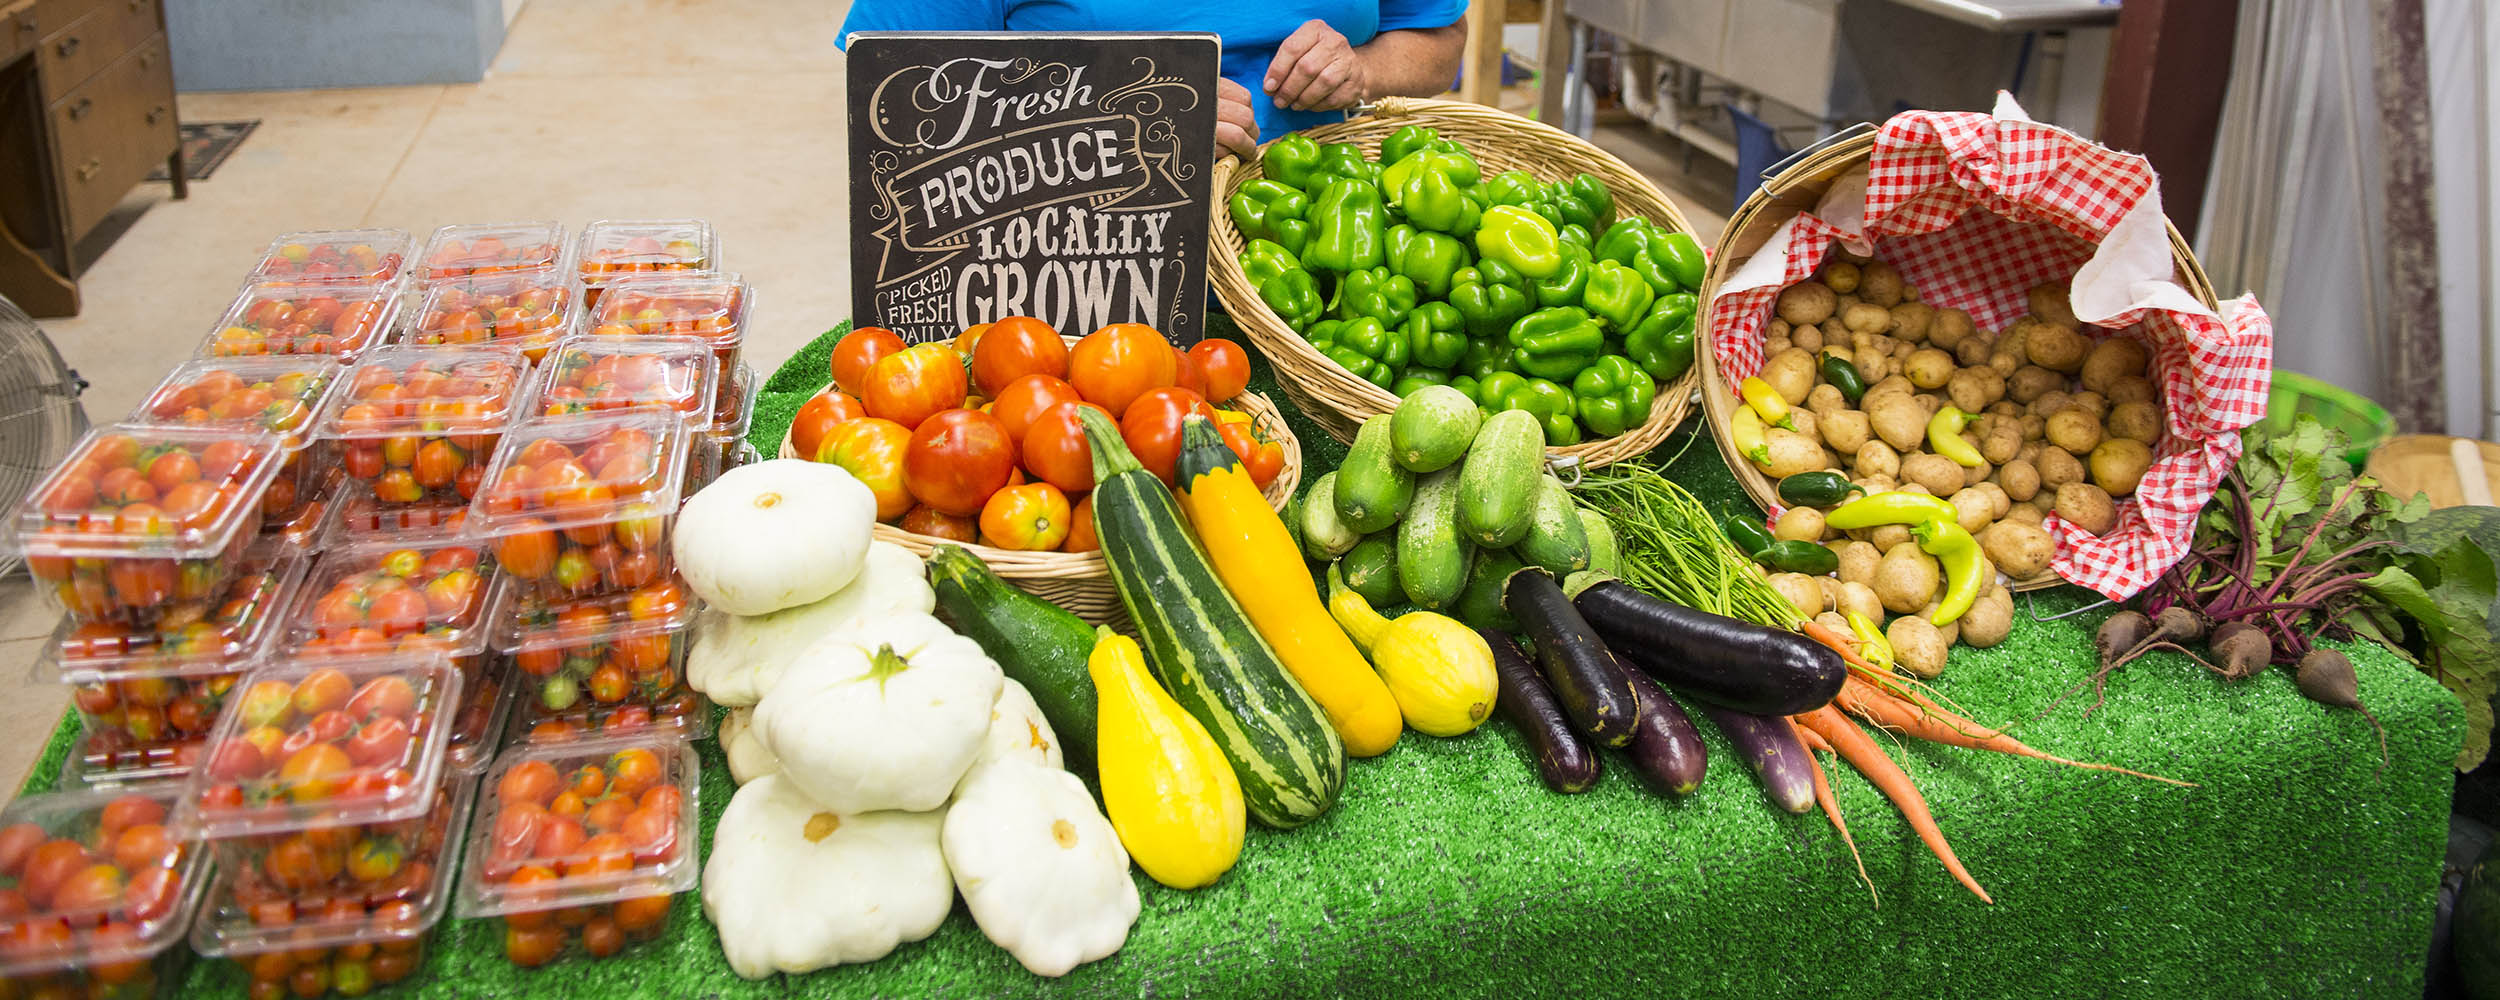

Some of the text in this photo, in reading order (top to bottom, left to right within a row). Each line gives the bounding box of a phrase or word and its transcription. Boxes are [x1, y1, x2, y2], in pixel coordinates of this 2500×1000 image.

[915, 57, 1096, 150] Fresh
[919, 130, 1124, 229] PRODUCE
[976, 205, 1171, 261] LOCALLY
[888, 292, 953, 324] FRESH
[889, 266, 952, 305] PICKED
[955, 258, 1164, 336] GROWN
